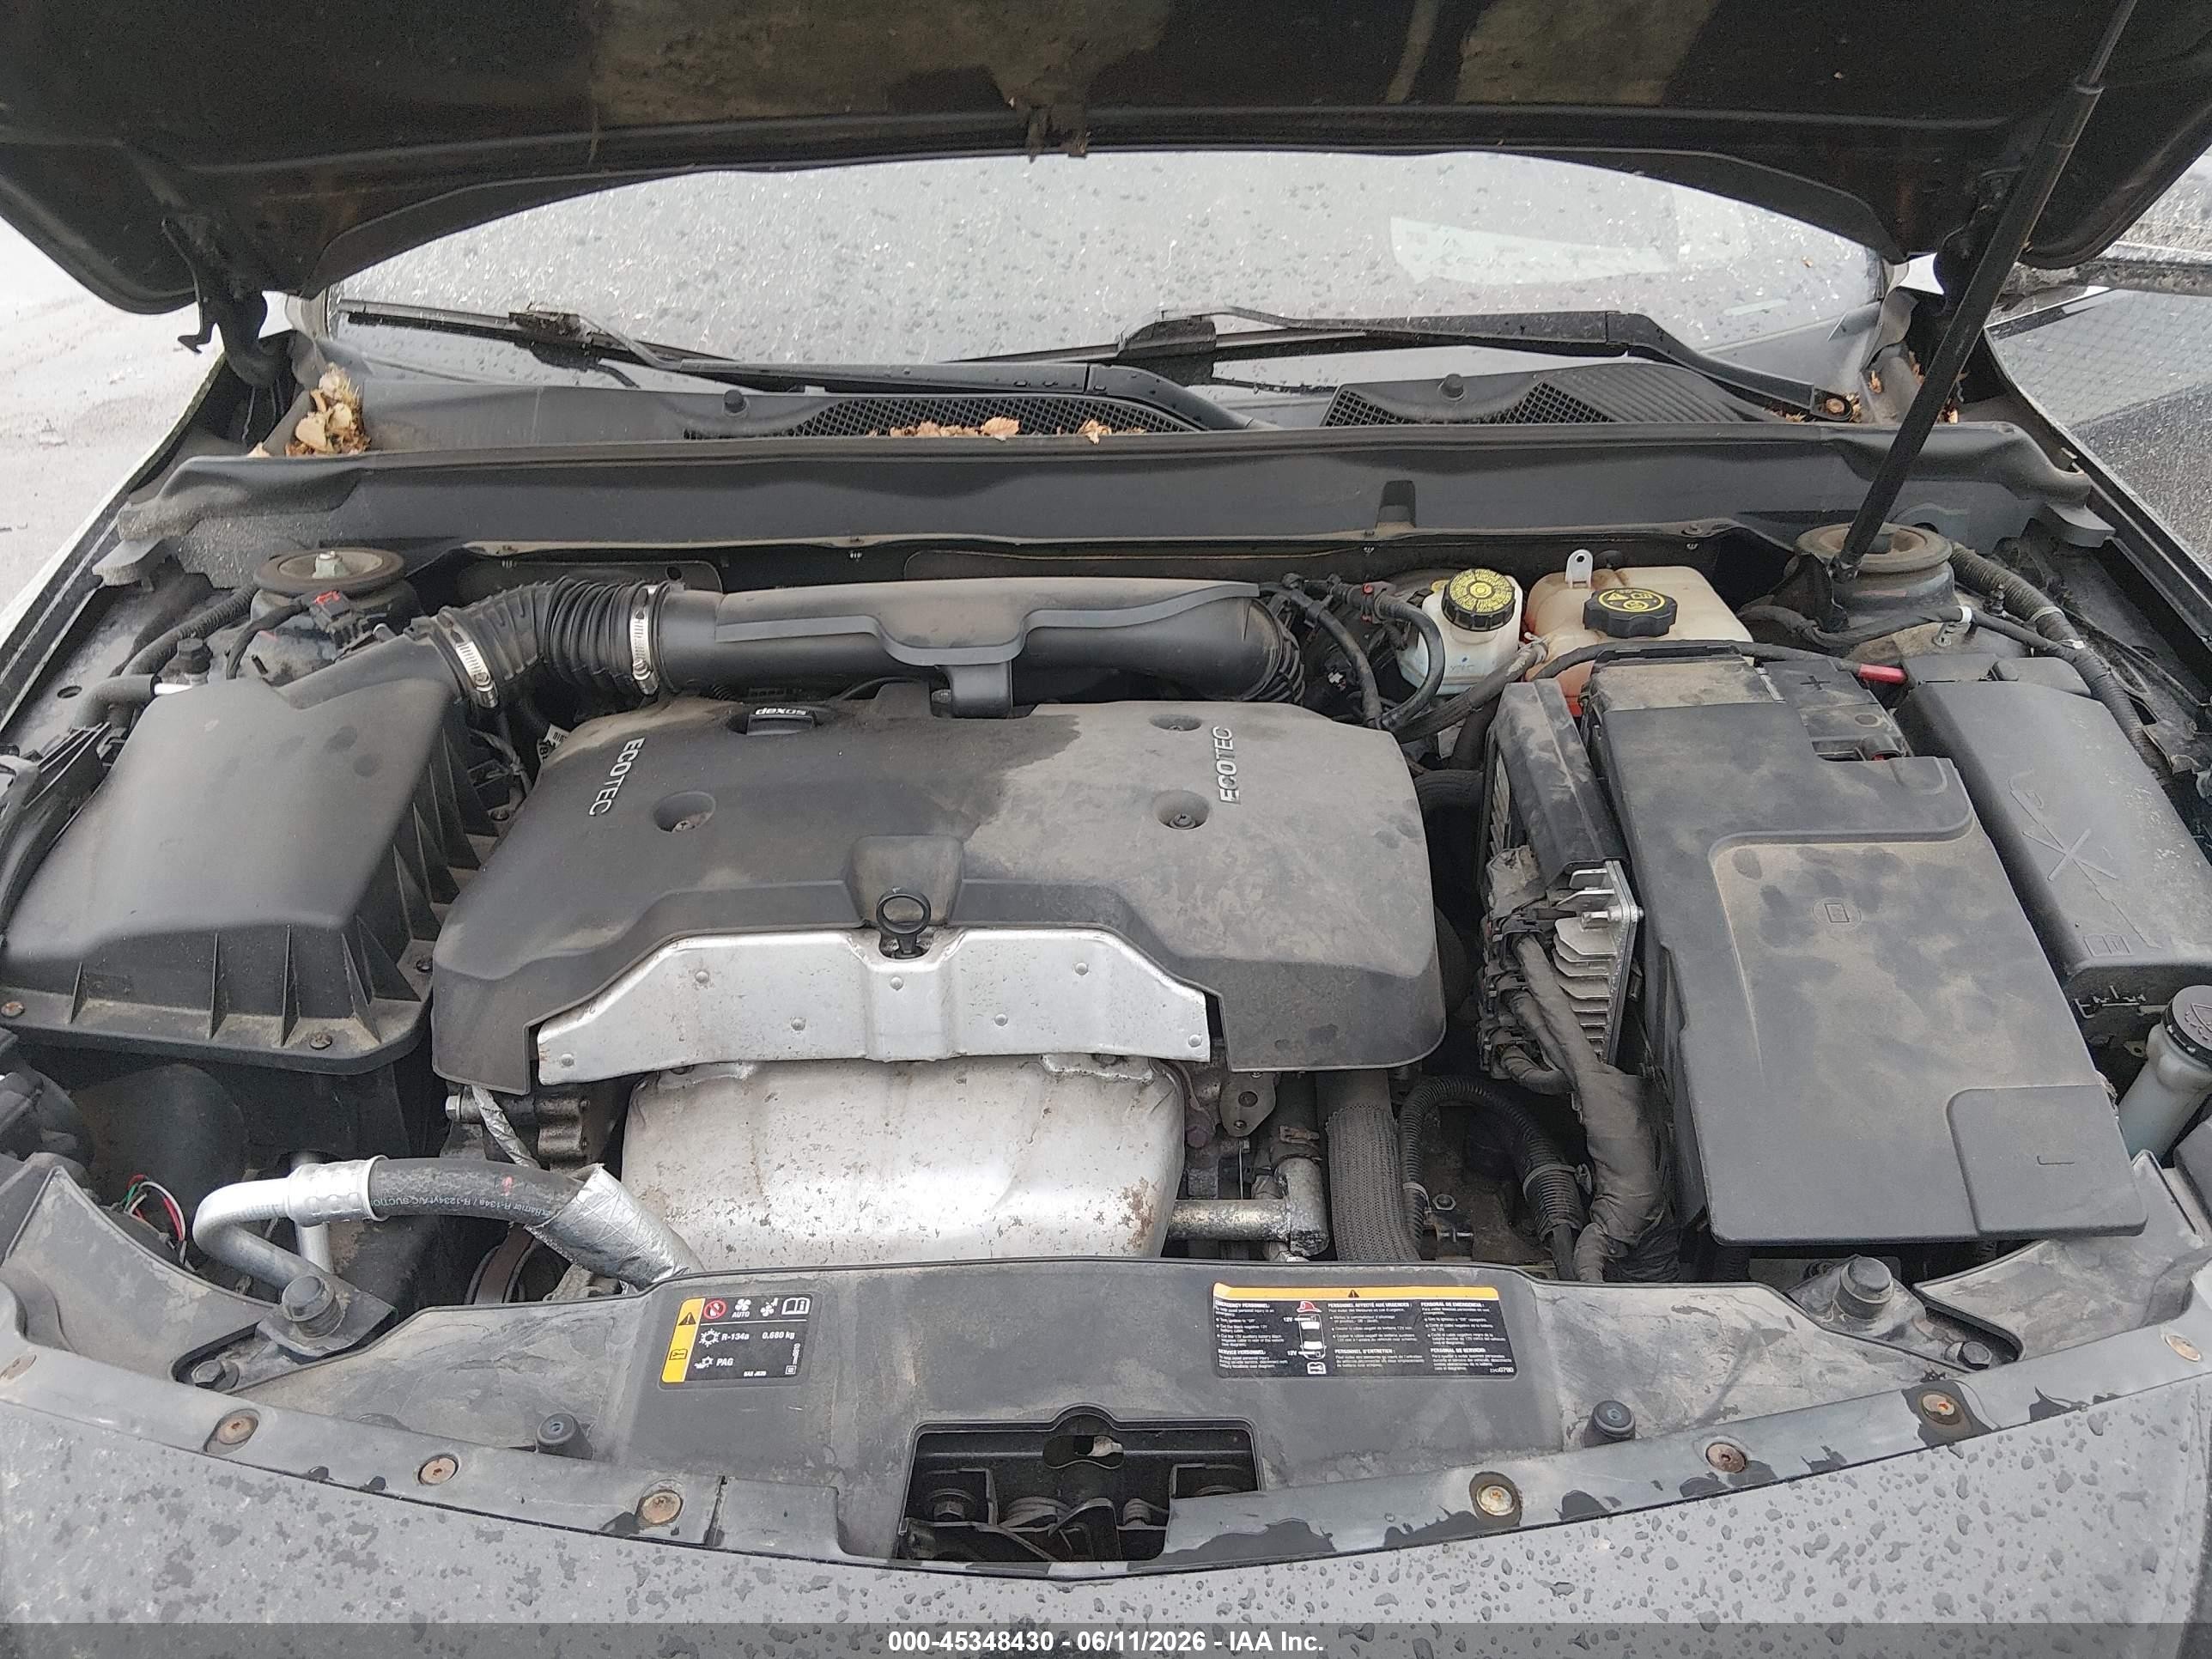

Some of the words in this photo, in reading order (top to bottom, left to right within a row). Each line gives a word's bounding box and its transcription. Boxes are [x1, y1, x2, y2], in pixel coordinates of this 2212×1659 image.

[589, 738, 646, 815] ECOTEC
[1212, 726, 1241, 805] ECOTEC
[721, 1332, 750, 1341] R-134a
[785, 1331, 795, 1340] kg
[716, 1358, 734, 1366] PAG
